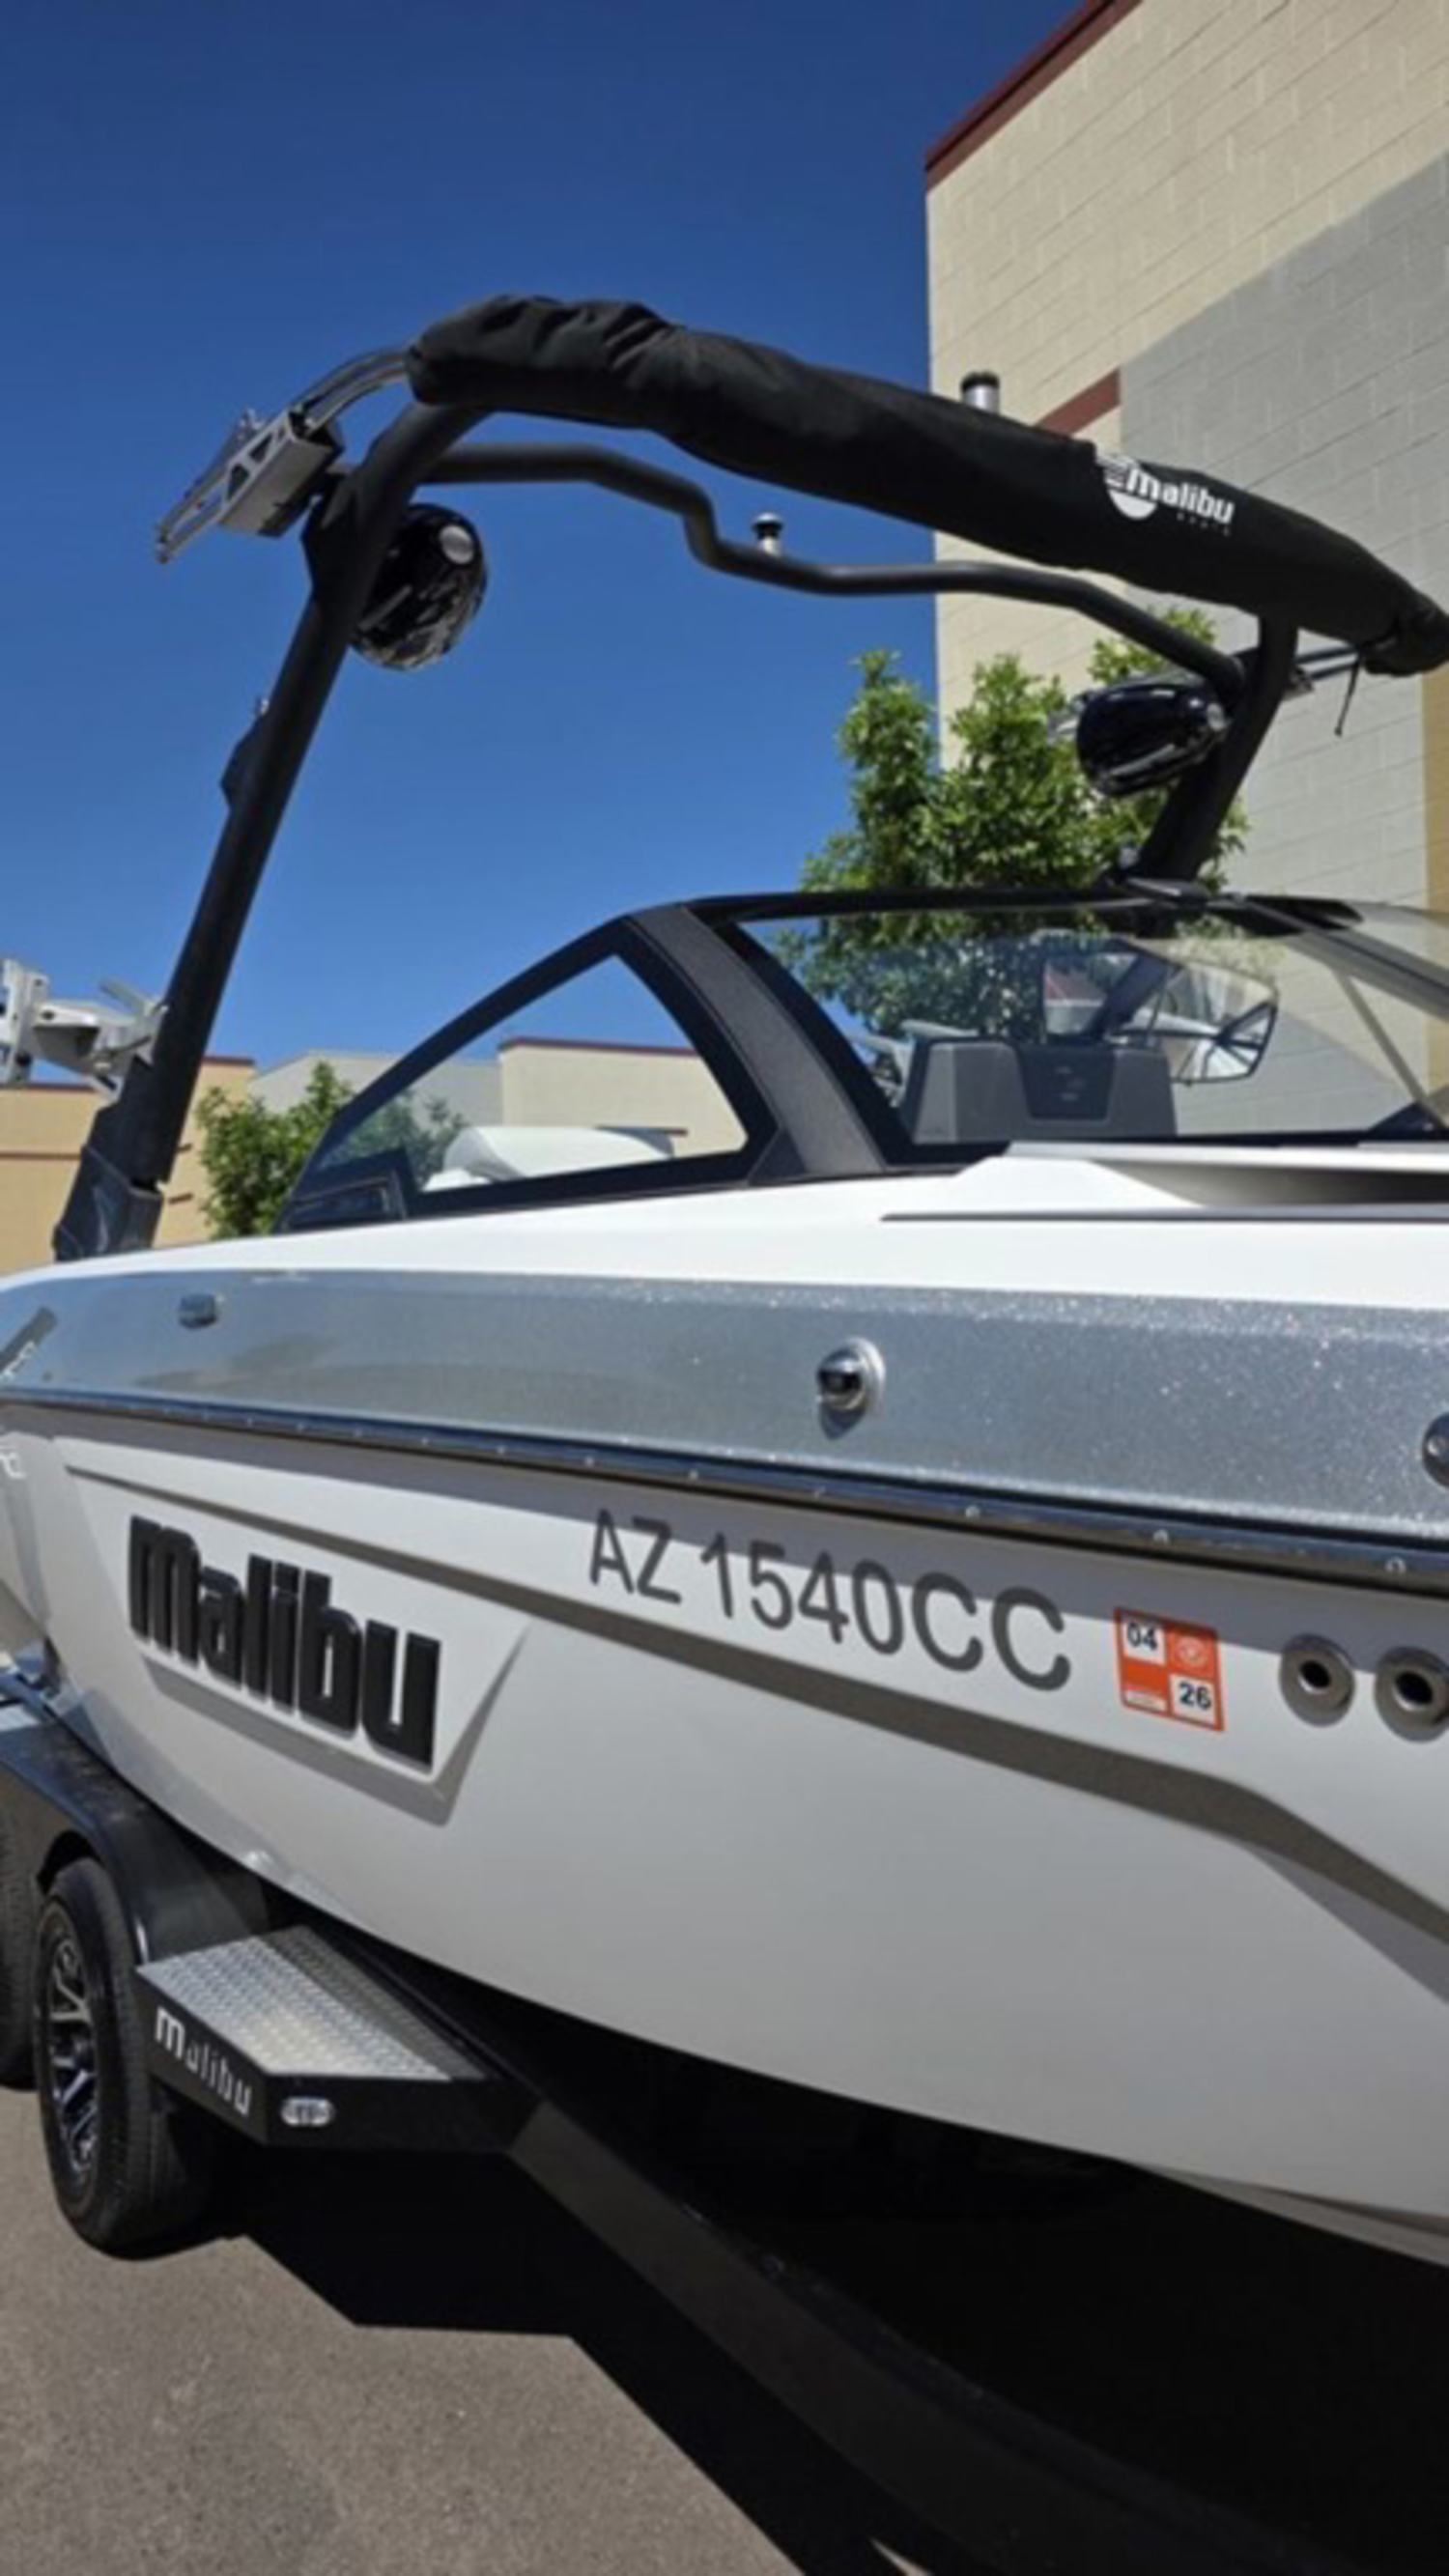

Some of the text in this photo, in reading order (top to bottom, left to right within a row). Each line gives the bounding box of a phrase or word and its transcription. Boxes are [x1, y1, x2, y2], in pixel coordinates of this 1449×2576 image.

[589, 1508, 682, 1605] AZ
[1126, 1622, 1157, 1651] 04
[1179, 1679, 1211, 1711] 26
